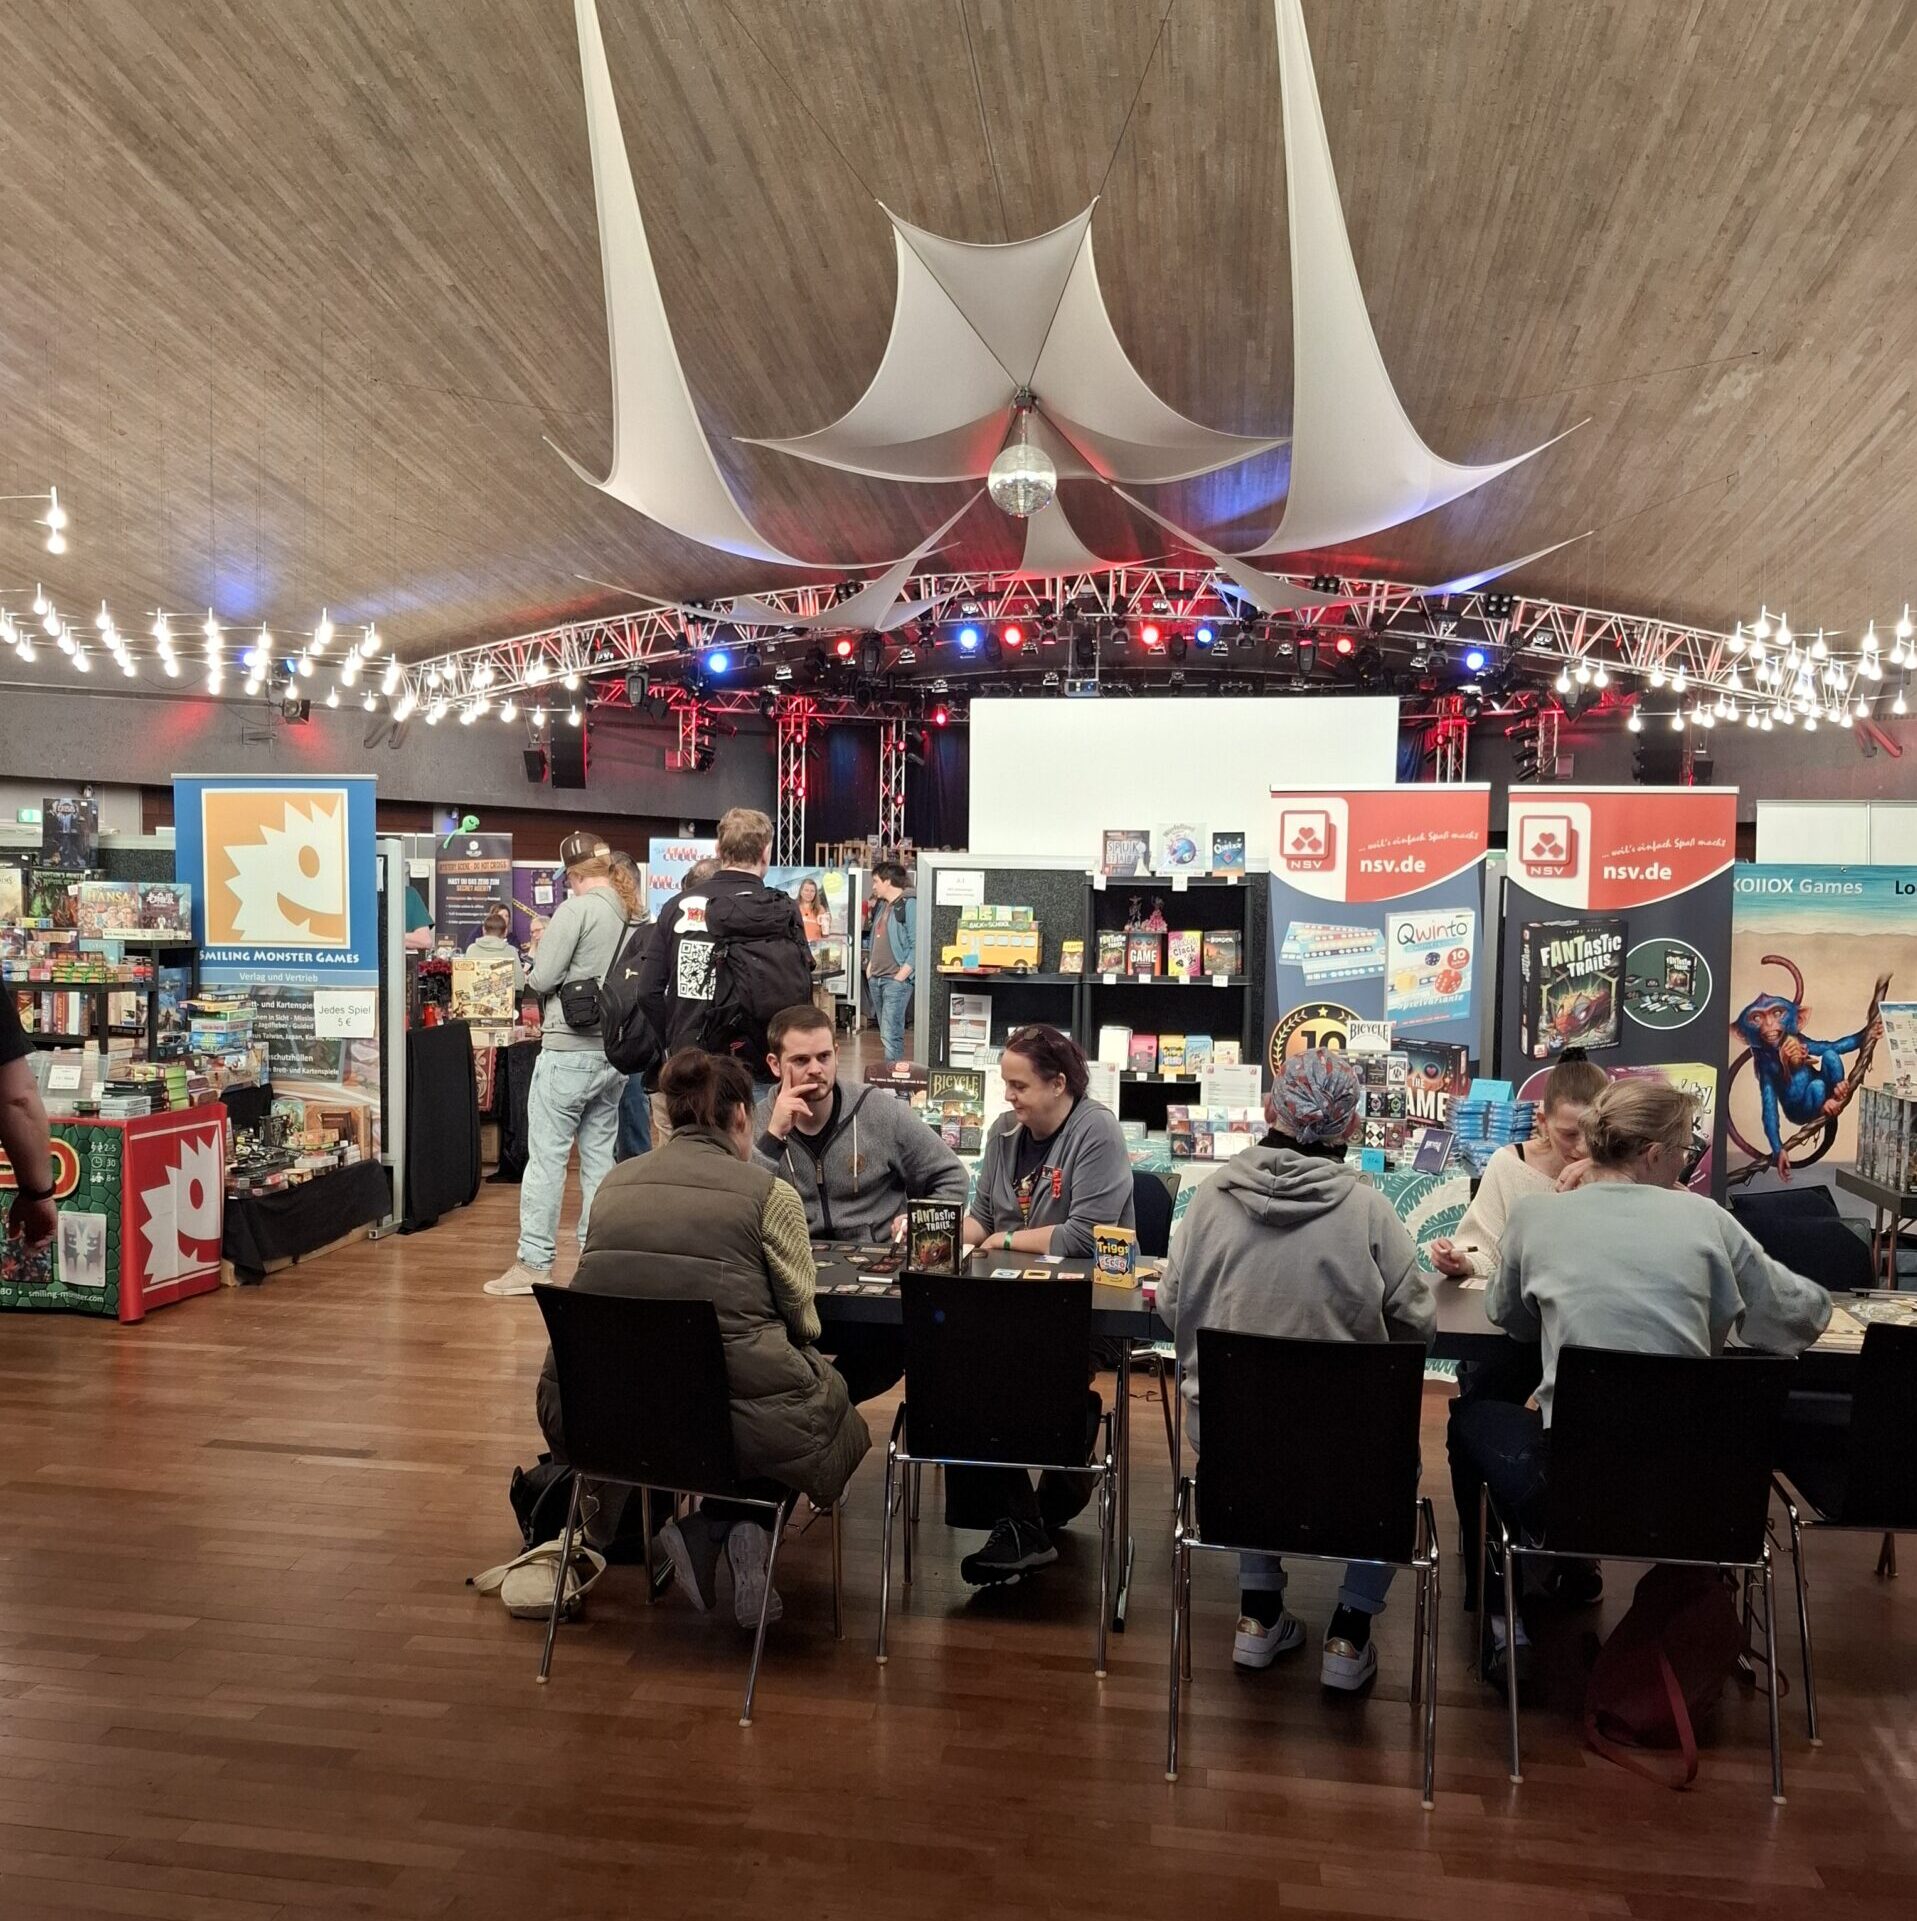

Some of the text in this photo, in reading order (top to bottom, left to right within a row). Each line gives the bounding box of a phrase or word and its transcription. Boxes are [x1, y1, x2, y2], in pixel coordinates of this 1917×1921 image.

[1393, 834, 1425, 846] einfach
[1428, 832, 1449, 842] Spaß
[1451, 831, 1478, 840] macht
[1637, 840, 1672, 852] einfach
[1674, 838, 1696, 849] Spaß
[1698, 838, 1726, 848] macht
[1290, 860, 1322, 869] NSV
[1360, 855, 1426, 873] nsv.de
[1530, 866, 1564, 876] NSV
[1603, 862, 1672, 880] nsv.de
[1800, 879, 1863, 894] Games
[88, 891, 130, 902] HANSA
[1397, 922, 1468, 945] Qwinto
[1173, 945, 1196, 956] Clack
[1452, 950, 1464, 960] 10
[200, 949, 360, 964] SMILING MONSTER GAMES
[1130, 950, 1156, 963] GAME
[240, 972, 318, 982] Verlag und Vertrieb
[276, 1001, 314, 1010] Kartenspie
[318, 1006, 371, 1016] Jedes Spiel
[275, 1014, 289, 1022] Sicht
[338, 1018, 352, 1027] 5 €
[292, 1022, 314, 1030] Guided
[1350, 1023, 1388, 1041] BICYCLE
[302, 1068, 339, 1076] Kartenspiele
[933, 1074, 978, 1100] BICYCLE
[1412, 1076, 1425, 1088] THE
[1406, 1087, 1450, 1122] AME
[104, 1144, 116, 1152] 2-5
[106, 1159, 116, 1167] 30
[1097, 1241, 1129, 1256] Triggs
